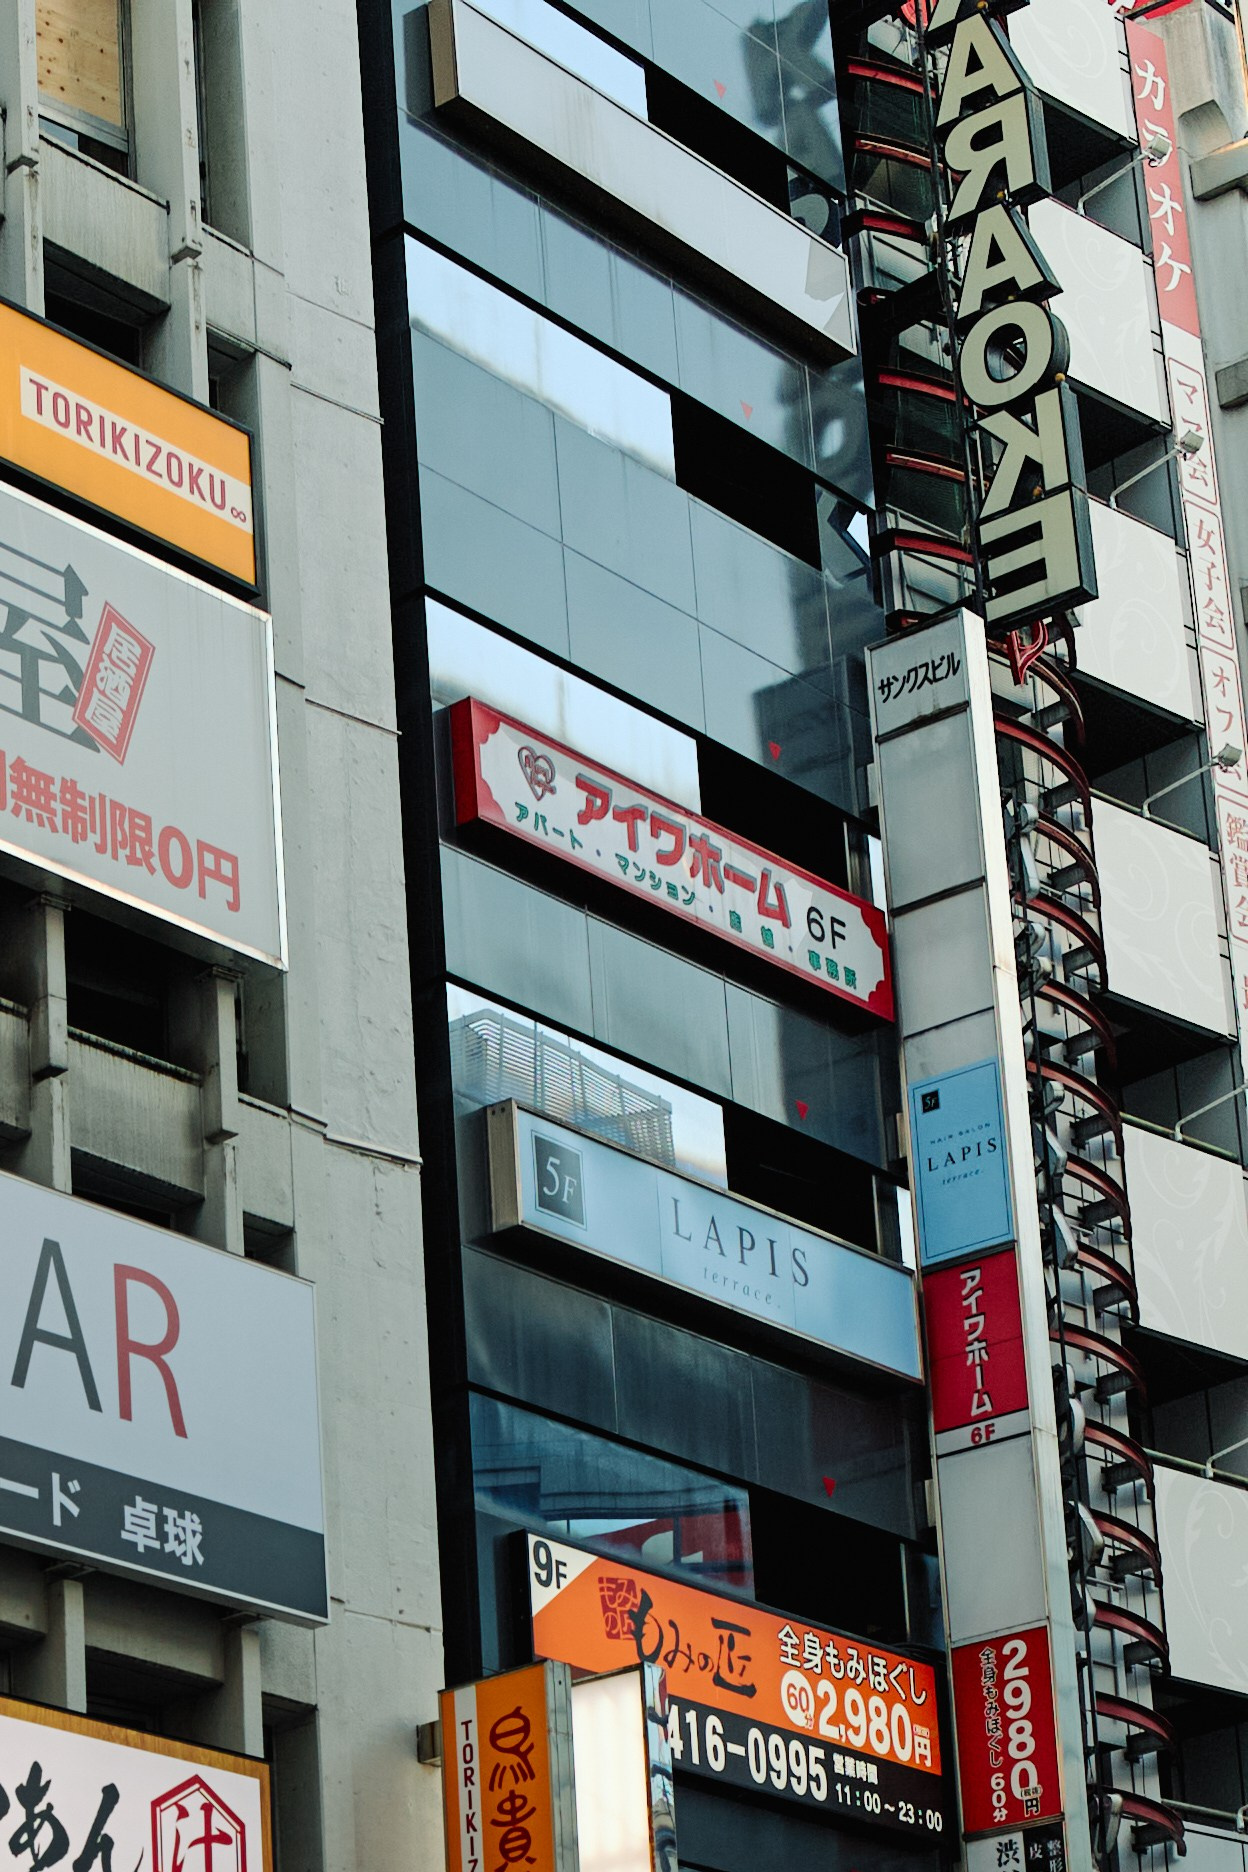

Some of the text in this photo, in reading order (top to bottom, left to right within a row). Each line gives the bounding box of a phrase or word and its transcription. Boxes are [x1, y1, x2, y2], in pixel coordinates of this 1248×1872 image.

[1133, 58, 1193, 293] カラオケ
[28, 378, 227, 512] TORIKIZOKU
[878, 652, 961, 703] サンクスビル
[575, 773, 793, 929] アイワホーム
[806, 906, 847, 950] 6F
[542, 1157, 577, 1205] 5F
[927, 1137, 998, 1172] LAPIS
[670, 1197, 811, 1288] LAPIS
[959, 1266, 993, 1418] アイワホーム
[970, 1422, 997, 1445] 6F
[120, 1497, 204, 1567] 卓球
[533, 1539, 568, 1591] 9F
[777, 1623, 928, 1706] 全身もみほぐし
[981, 1647, 1004, 1770] 全身もみほぐし
[992, 1772, 1007, 1823] 60分
